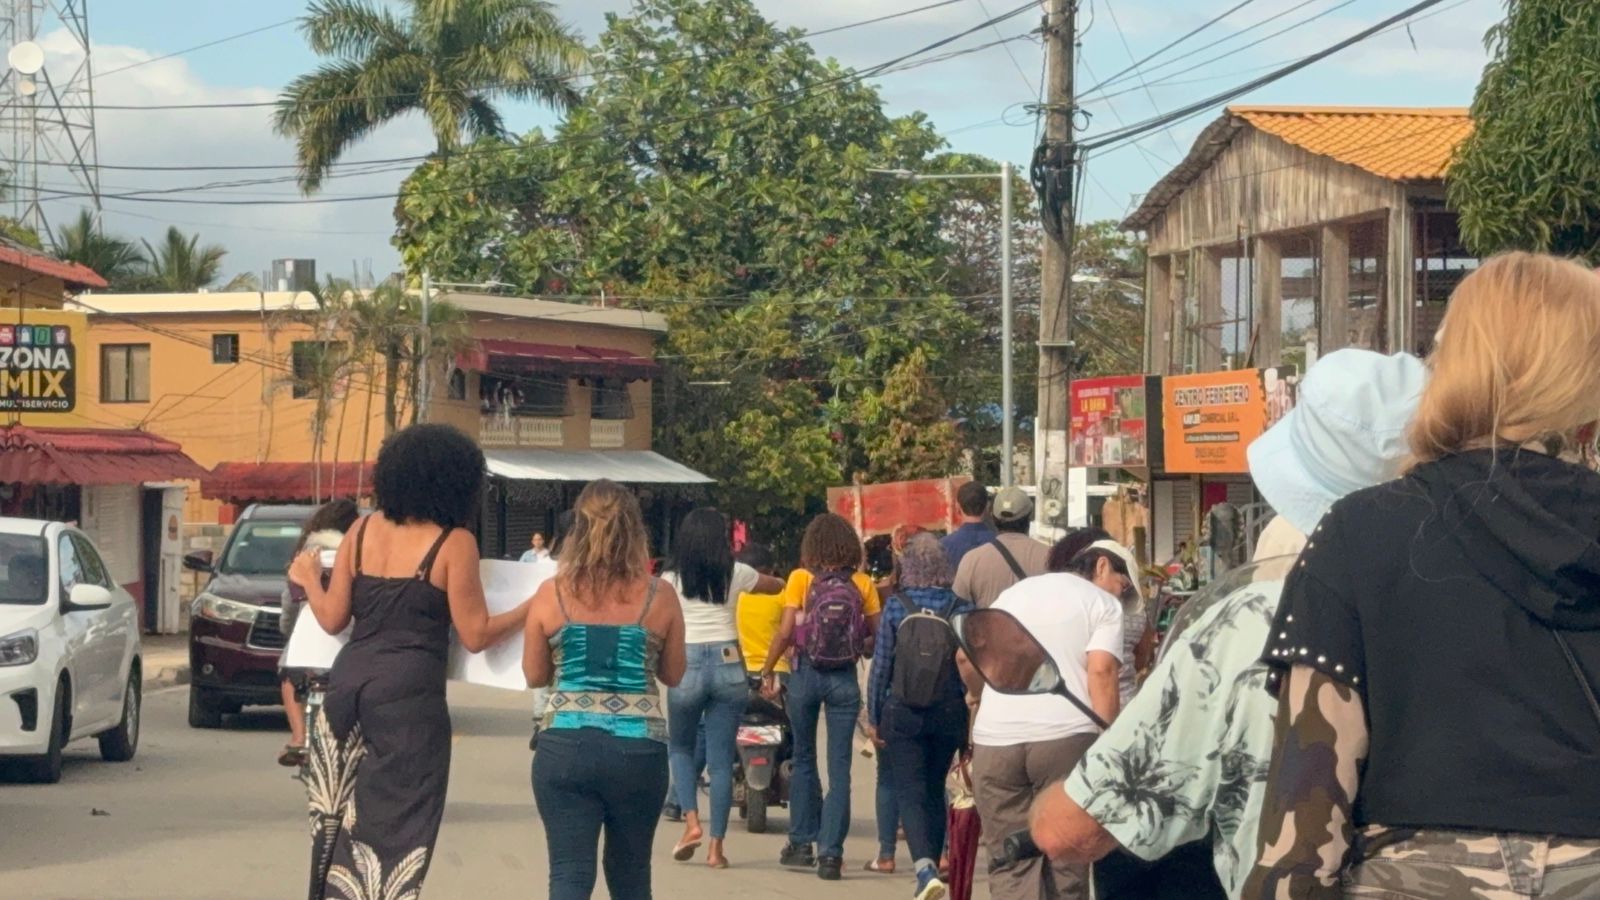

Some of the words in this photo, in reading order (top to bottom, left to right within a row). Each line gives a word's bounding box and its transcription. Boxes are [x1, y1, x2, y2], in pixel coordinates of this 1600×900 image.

[0, 346, 71, 369] ZONA
[0, 369, 66, 398] MIX
[1173, 387, 1203, 408] CENTRO
[1204, 383, 1249, 405] FERRETERO
